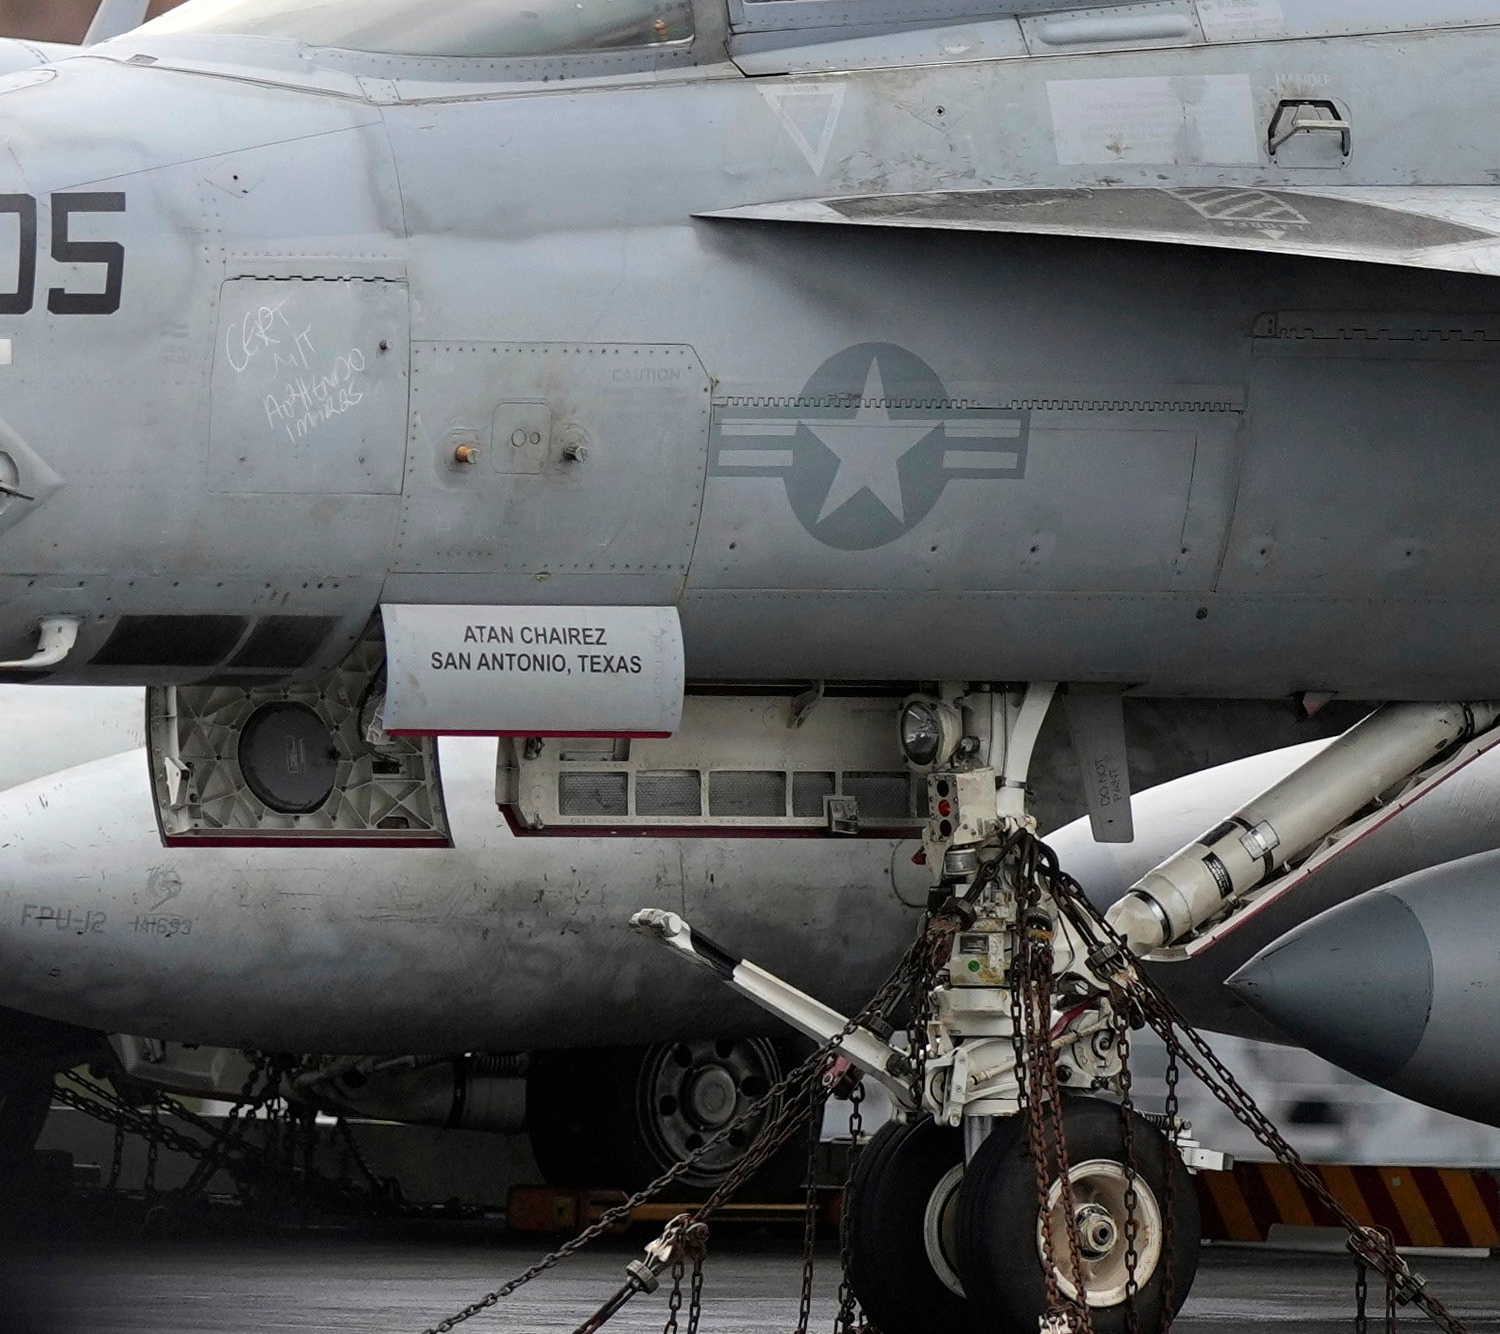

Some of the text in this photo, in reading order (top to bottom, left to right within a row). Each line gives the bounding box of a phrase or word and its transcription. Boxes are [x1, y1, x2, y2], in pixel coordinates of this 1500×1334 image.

[611, 368, 681, 383] CAUTION
[464, 625, 608, 645] ATAN CHAIREZ
[431, 652, 642, 675] SAN ANTONIO, TEXAS
